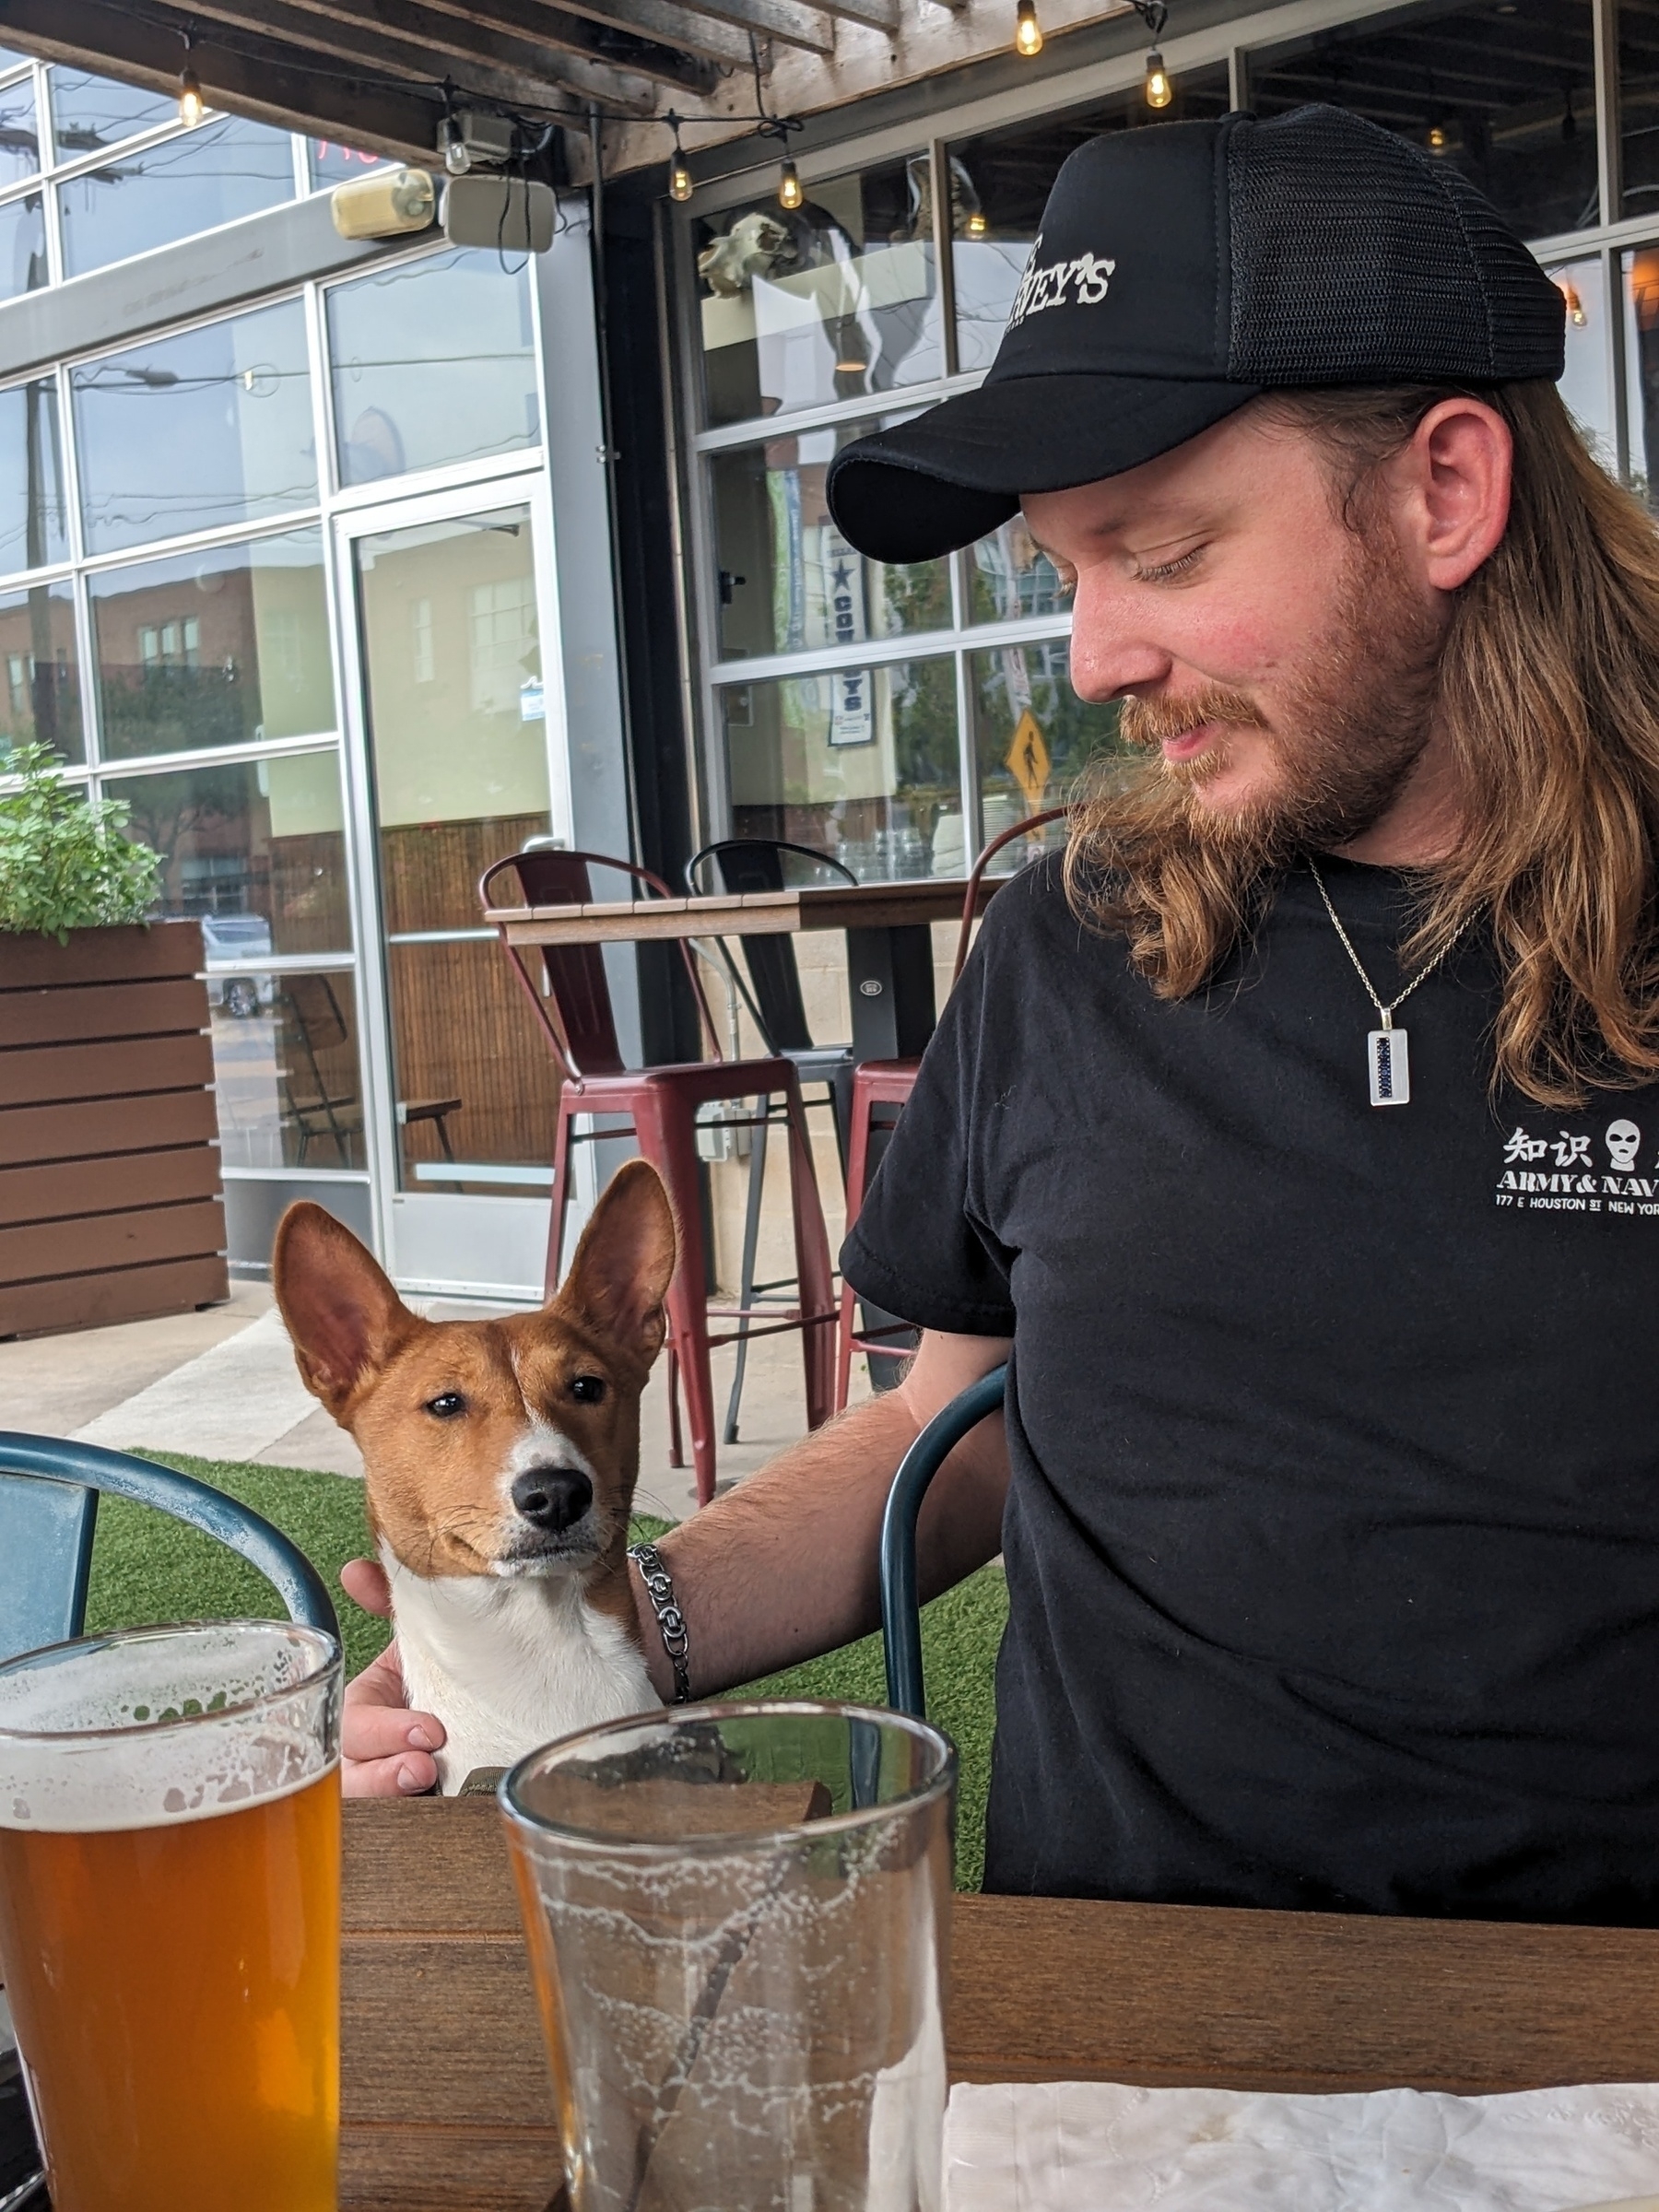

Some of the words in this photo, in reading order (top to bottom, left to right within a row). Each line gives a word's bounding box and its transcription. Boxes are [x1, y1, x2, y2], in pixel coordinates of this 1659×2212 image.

[1502, 1126, 1594, 1168] 知识
[1495, 1194, 1513, 1206] 177
[1517, 1196, 1525, 1208] E
[1529, 1197, 1586, 1211] HOUSTON
[1589, 1199, 1603, 1212] ST
[1608, 1200, 1635, 1215] NEW
